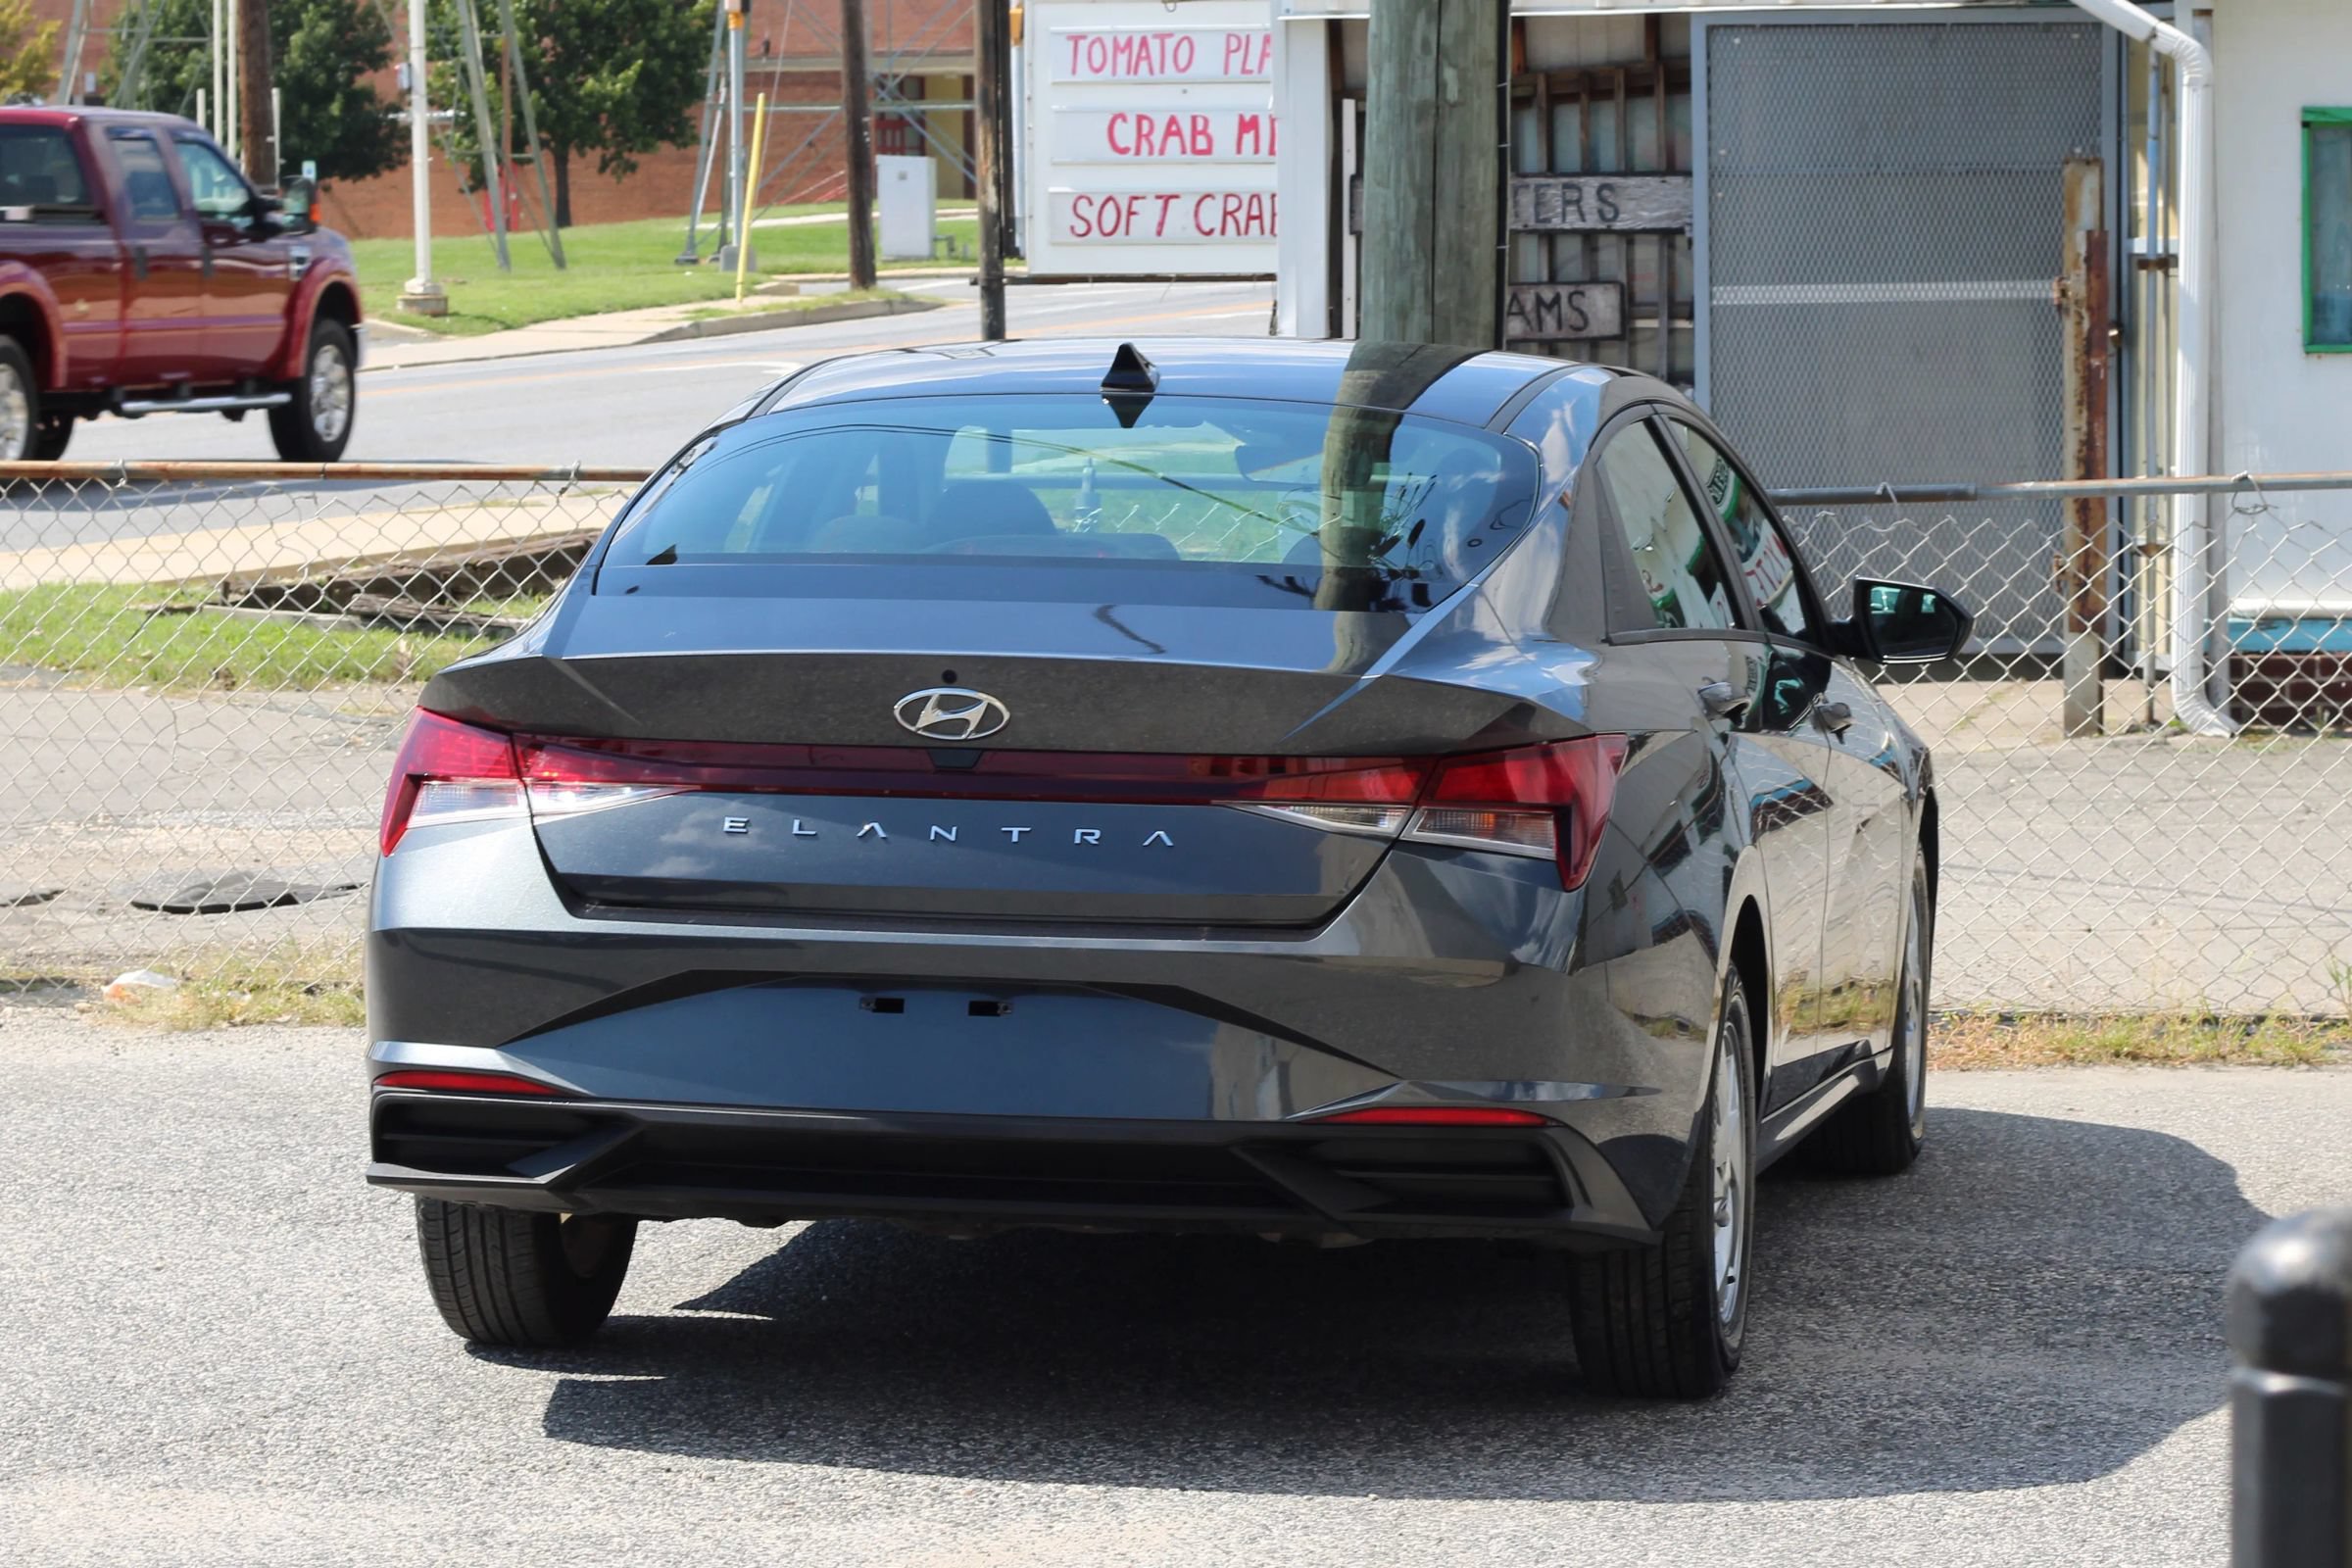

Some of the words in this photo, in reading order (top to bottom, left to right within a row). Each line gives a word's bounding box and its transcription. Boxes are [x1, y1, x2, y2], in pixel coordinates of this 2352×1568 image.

[1066, 32, 1195, 76] TOMATO
[1107, 112, 1213, 157] CRAB
[1069, 194, 1181, 237] SOFT
[723, 815, 1174, 847] ELANTRA
